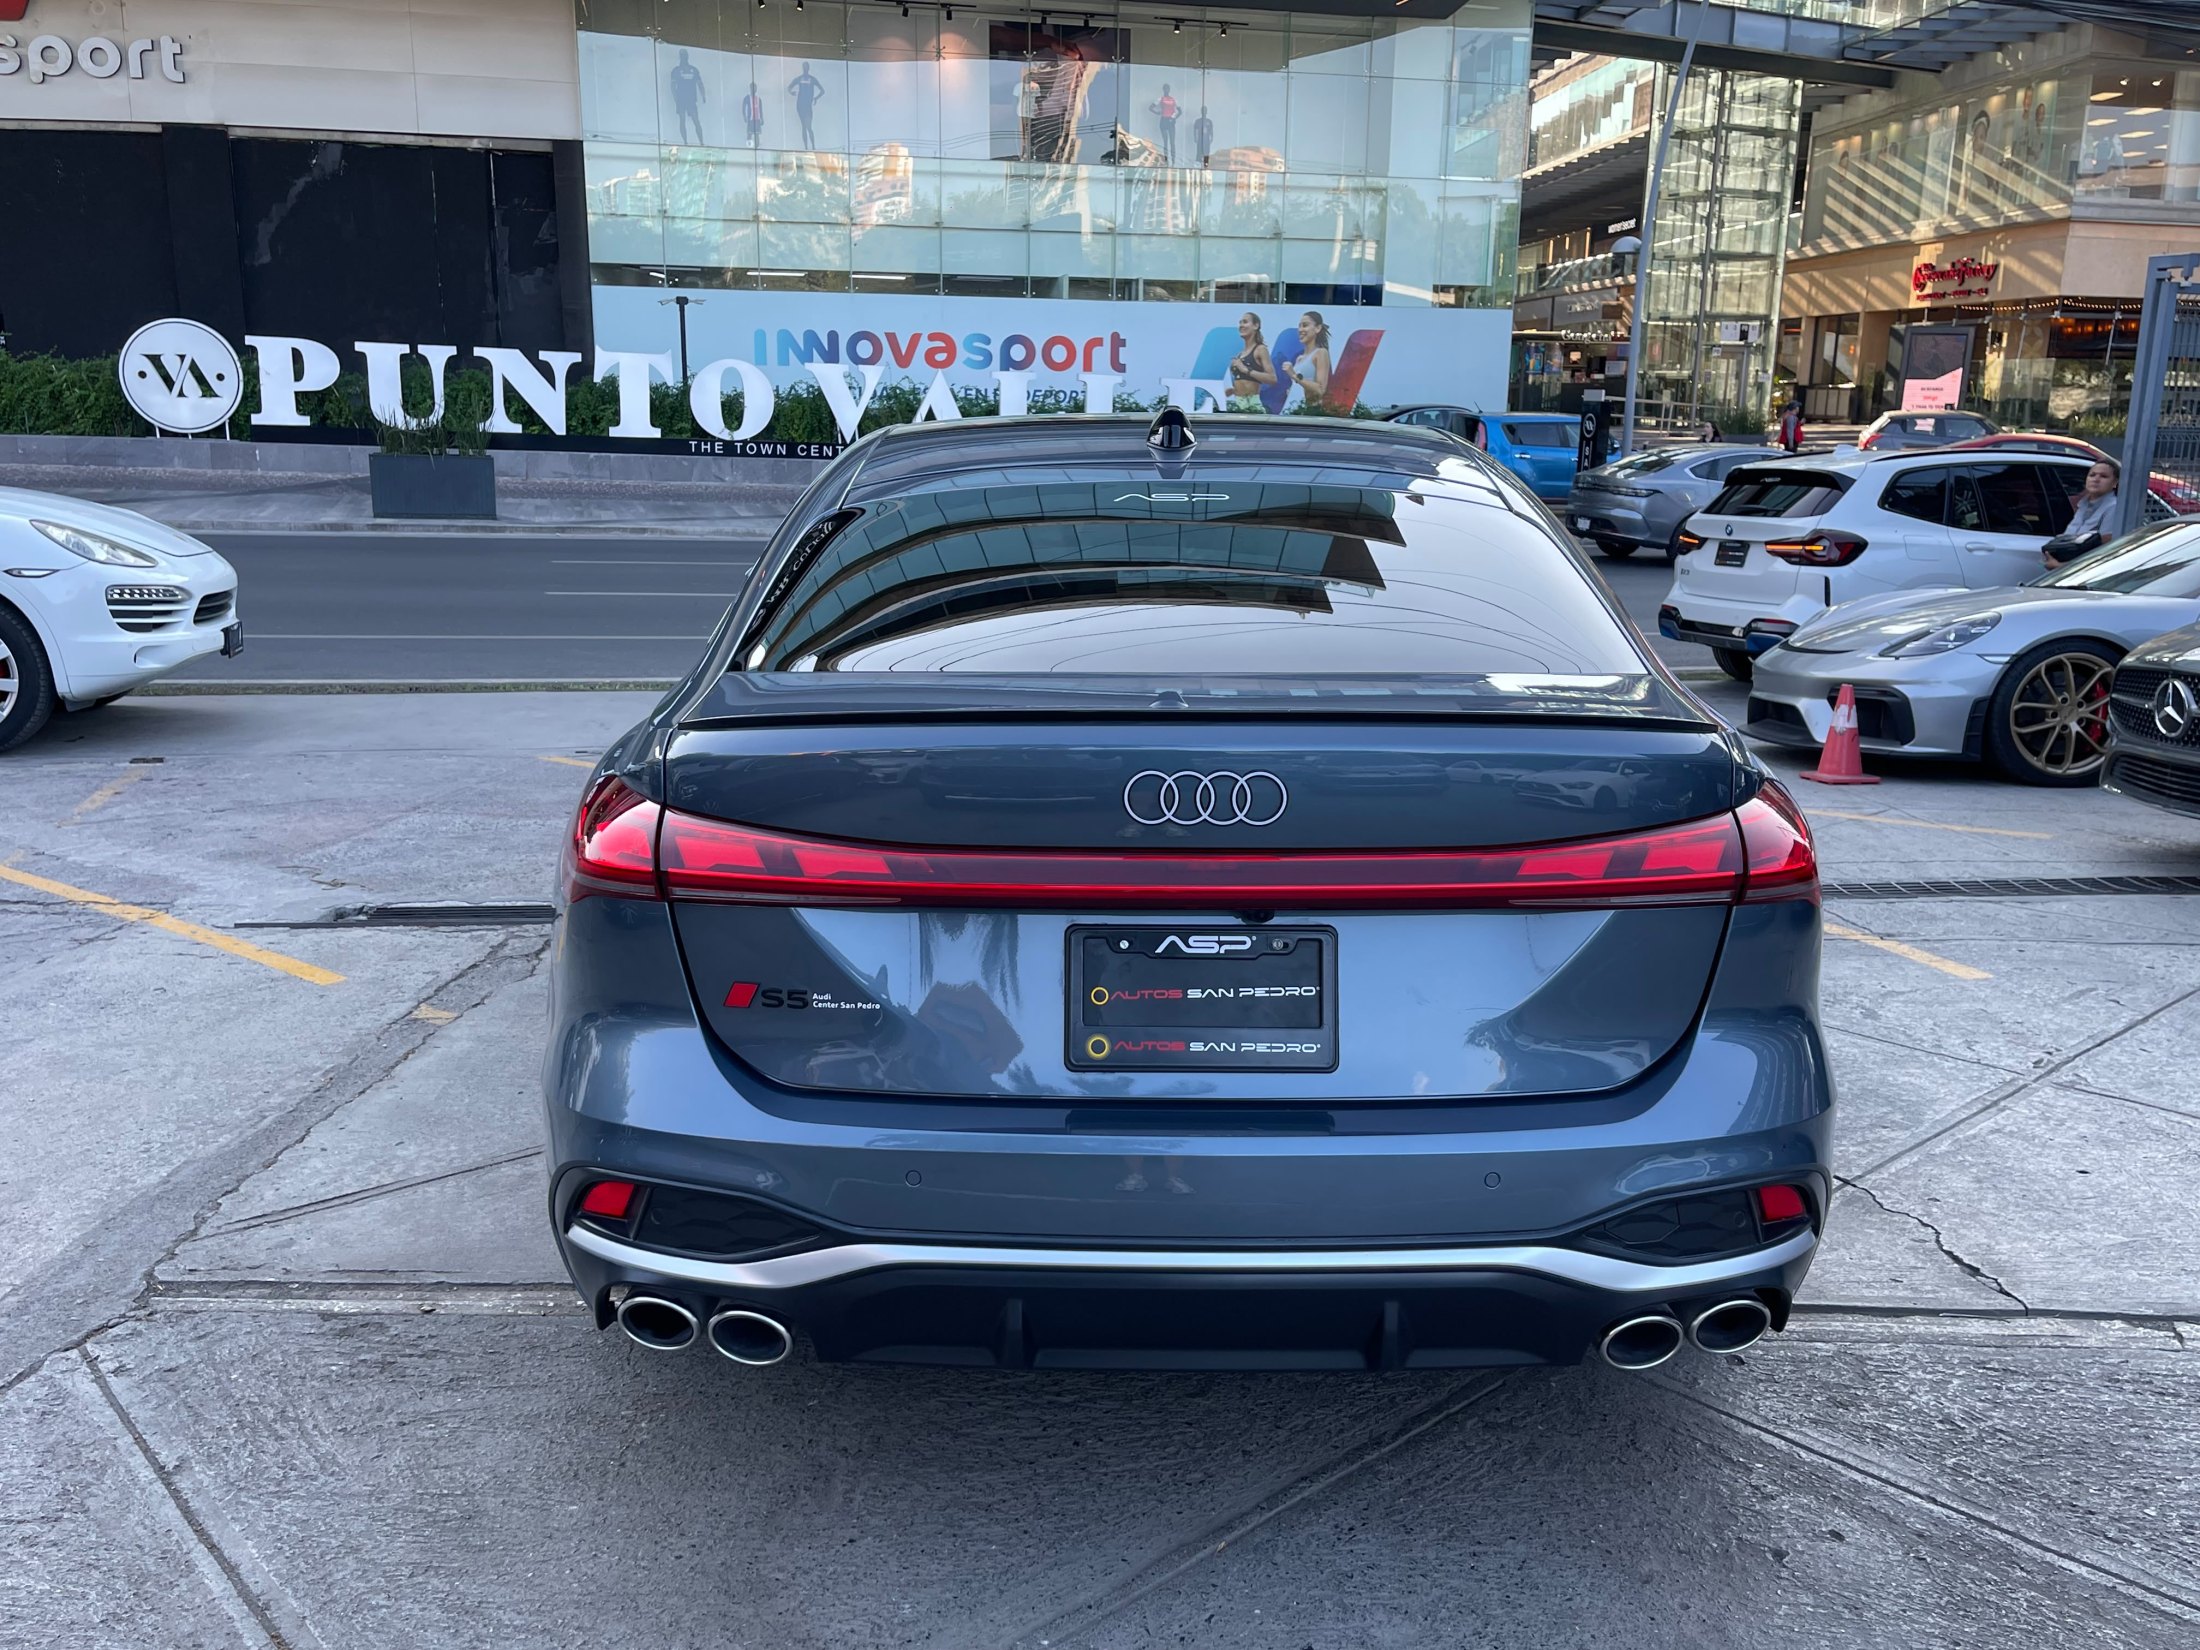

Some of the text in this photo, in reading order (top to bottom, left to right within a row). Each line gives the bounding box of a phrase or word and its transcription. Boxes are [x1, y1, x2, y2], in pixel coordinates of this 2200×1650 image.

[243, 334, 775, 441] PUNTO
[689, 441, 845, 457] THE TOWN CENT
[1154, 935, 1252, 954] ASP
[760, 988, 809, 1010] S5
[1110, 986, 1317, 1000] AUTOS SAN PEDRO
[812, 1001, 880, 1010] Center San Pedro
[1114, 1040, 1318, 1054] AUTOS SAN PEDRO
